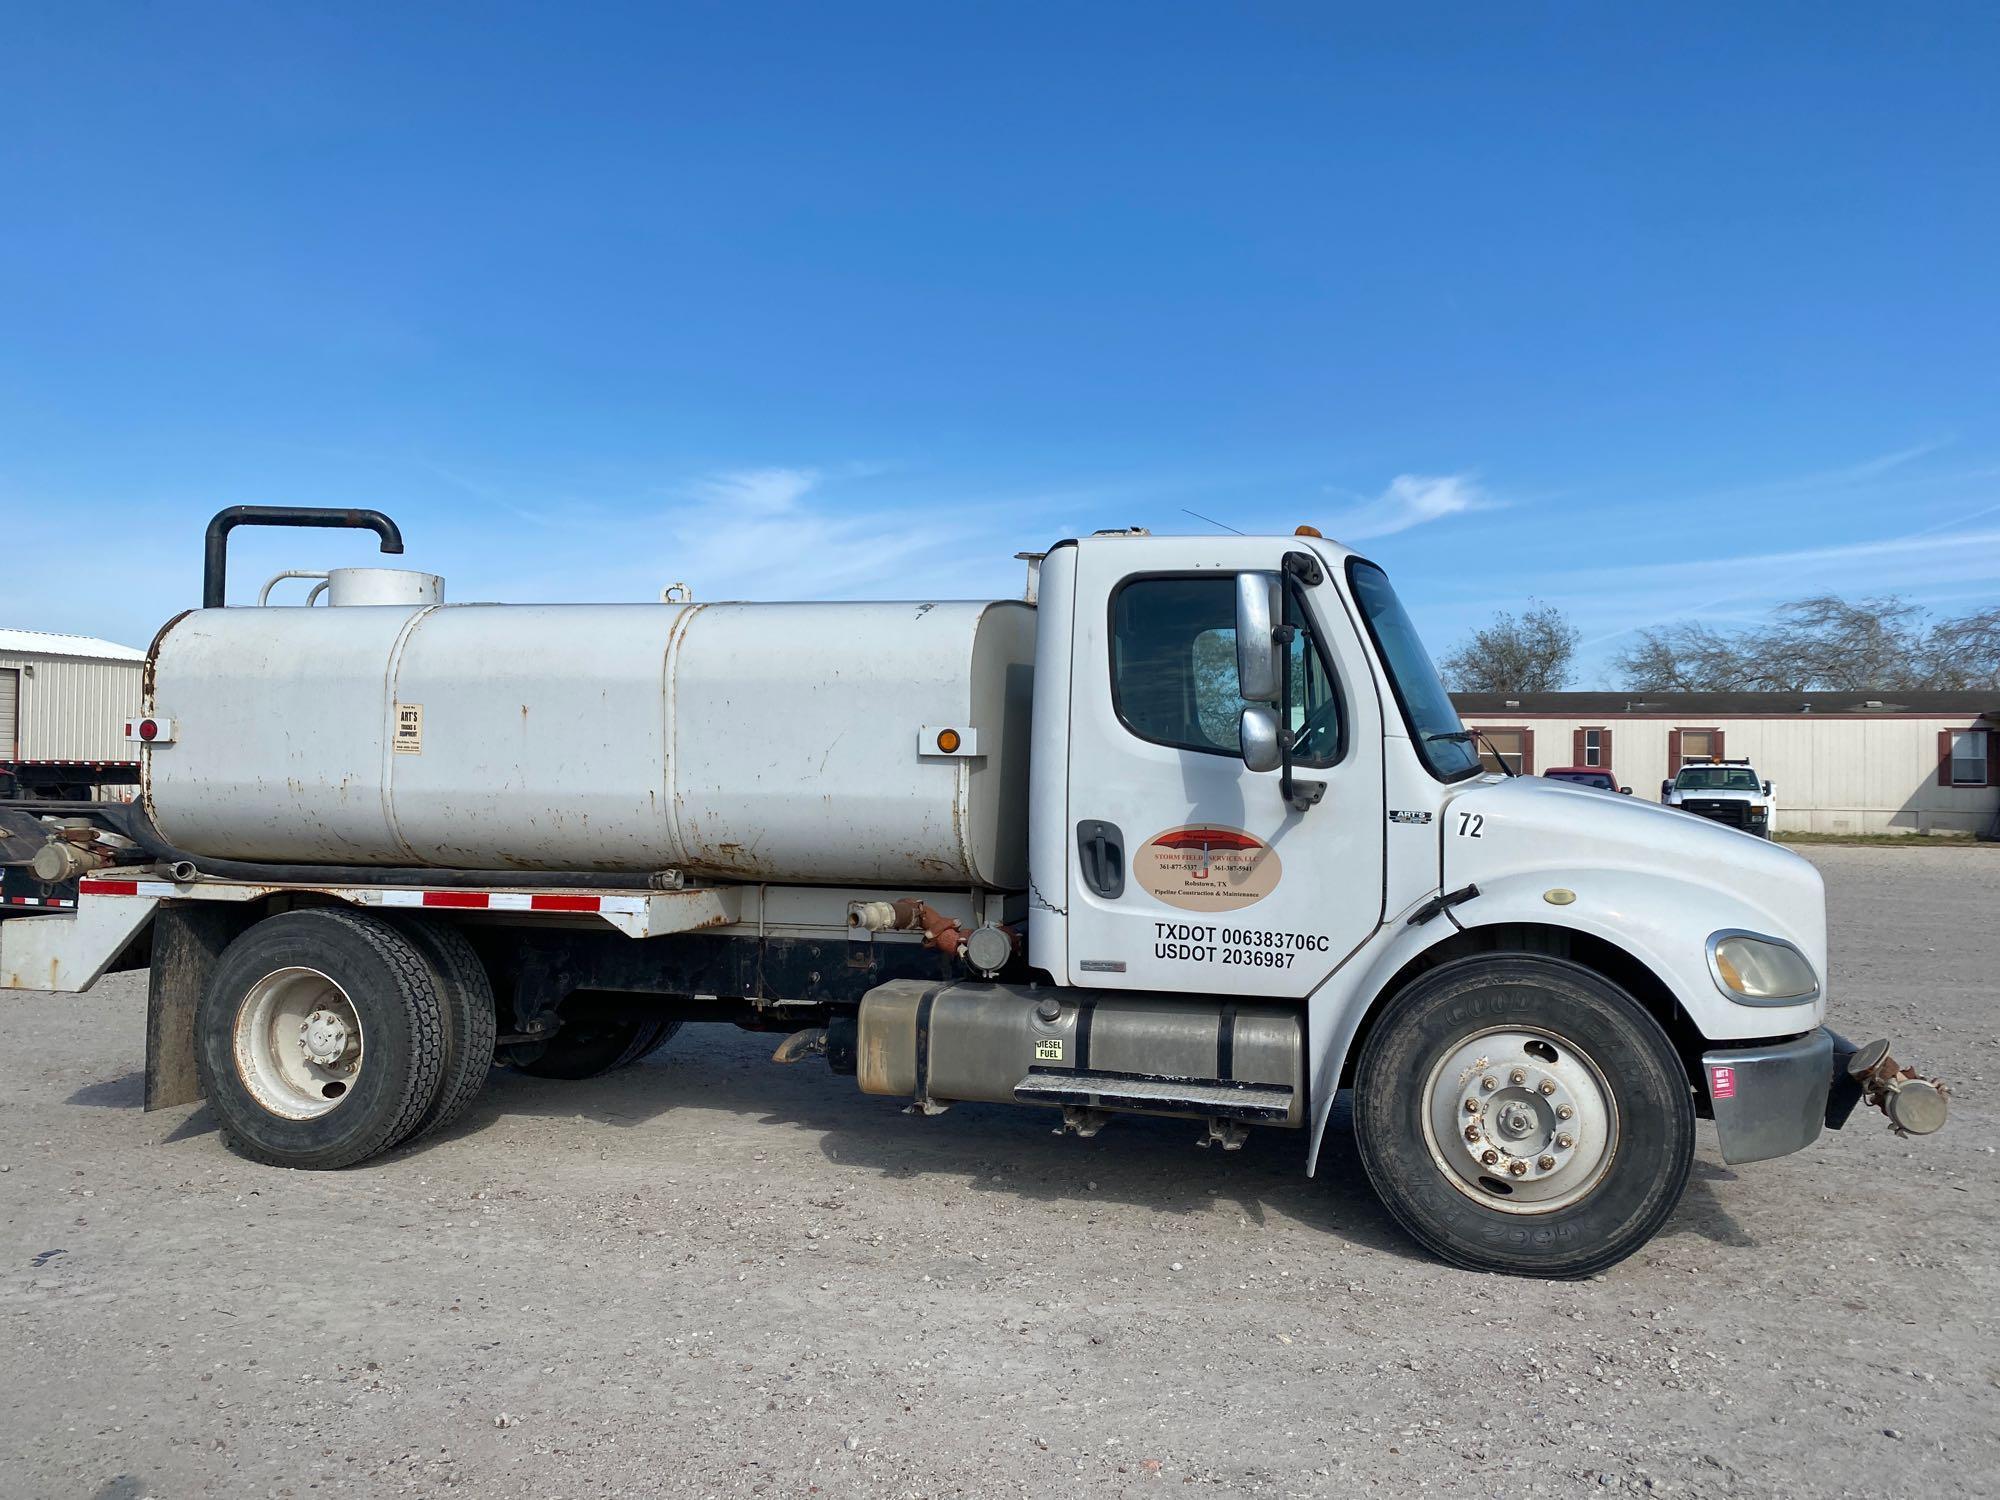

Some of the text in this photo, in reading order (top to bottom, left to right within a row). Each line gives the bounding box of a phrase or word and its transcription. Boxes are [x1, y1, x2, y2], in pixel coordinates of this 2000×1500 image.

[401, 711, 417, 722] ART'S
[1459, 812, 1484, 838] 72
[1154, 922, 1330, 952] TXDOT 006383706C
[1154, 943, 1296, 968] USDOT 2036987
